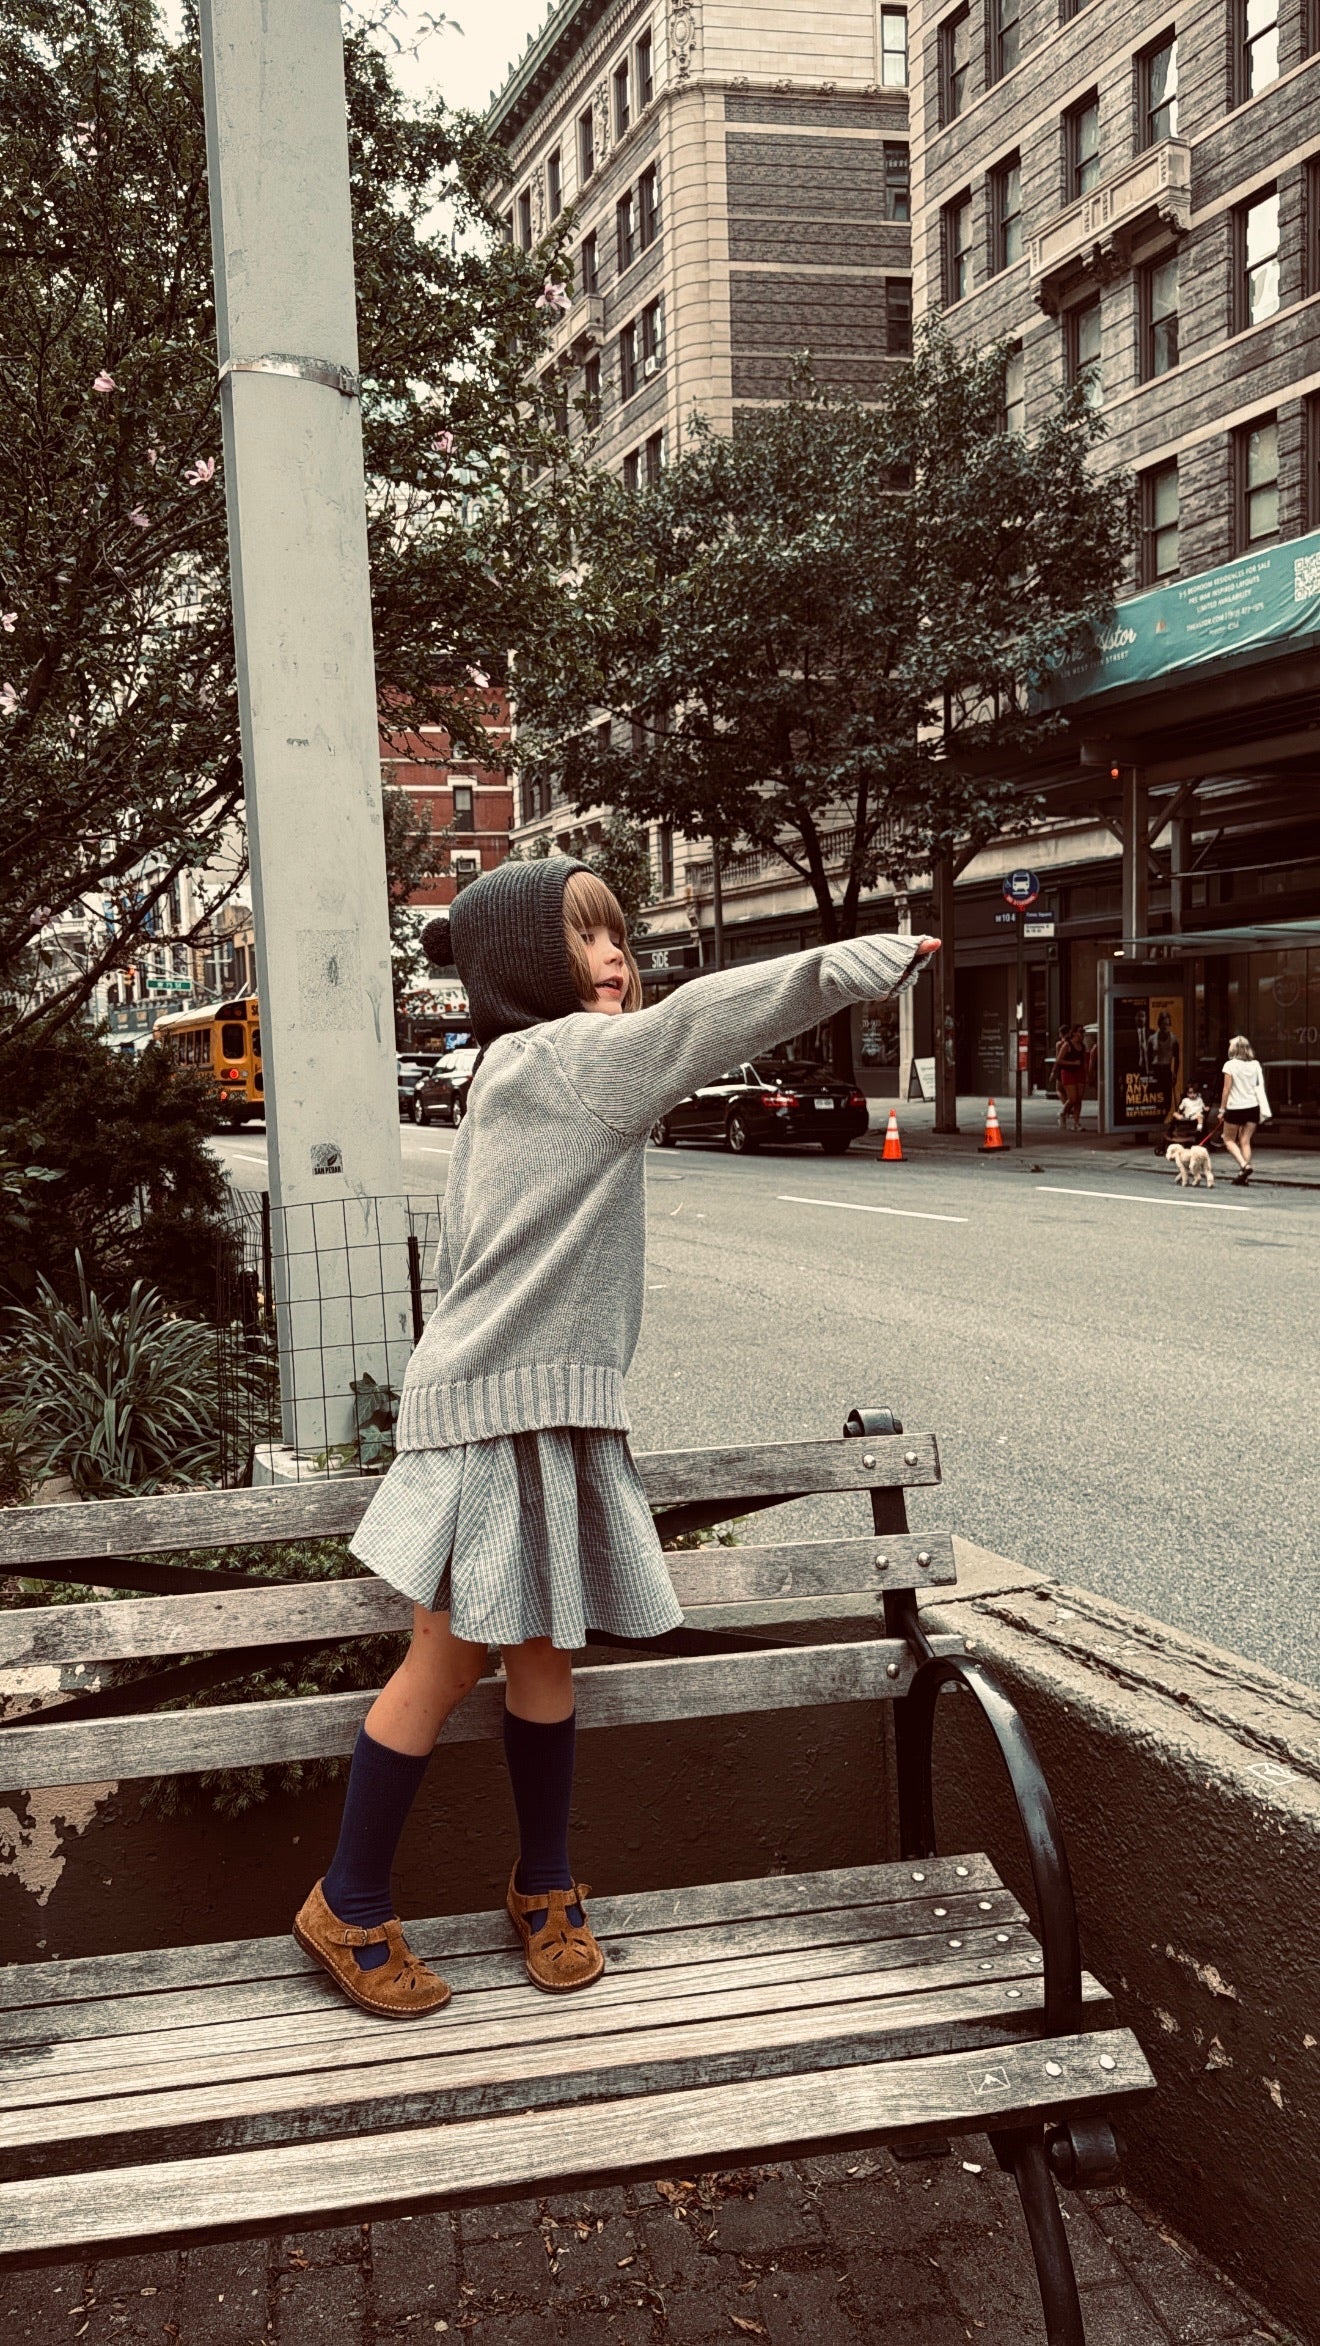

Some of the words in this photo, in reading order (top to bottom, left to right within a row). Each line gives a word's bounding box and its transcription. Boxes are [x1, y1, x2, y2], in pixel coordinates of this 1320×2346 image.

[1187, 581, 1213, 595] BEDROOM
[1213, 569, 1245, 585] RESIDENCES
[1245, 565, 1257, 575] FOR
[1257, 559, 1271, 571] SALE
[1211, 583, 1235, 598] INSPIRED
[1235, 575, 1260, 589] LAYOUTS
[1196, 600, 1217, 613] LIMITED
[1218, 588, 1252, 606] AVAILABILITY
[1095, 624, 1137, 652] Astor
[1105, 650, 1129, 665] STREET
[651, 951, 669, 969] SIDE
[1125, 1073, 1140, 1085] BY
[1125, 1083, 1149, 1095] ANY
[1125, 1092, 1164, 1105] MEANS
